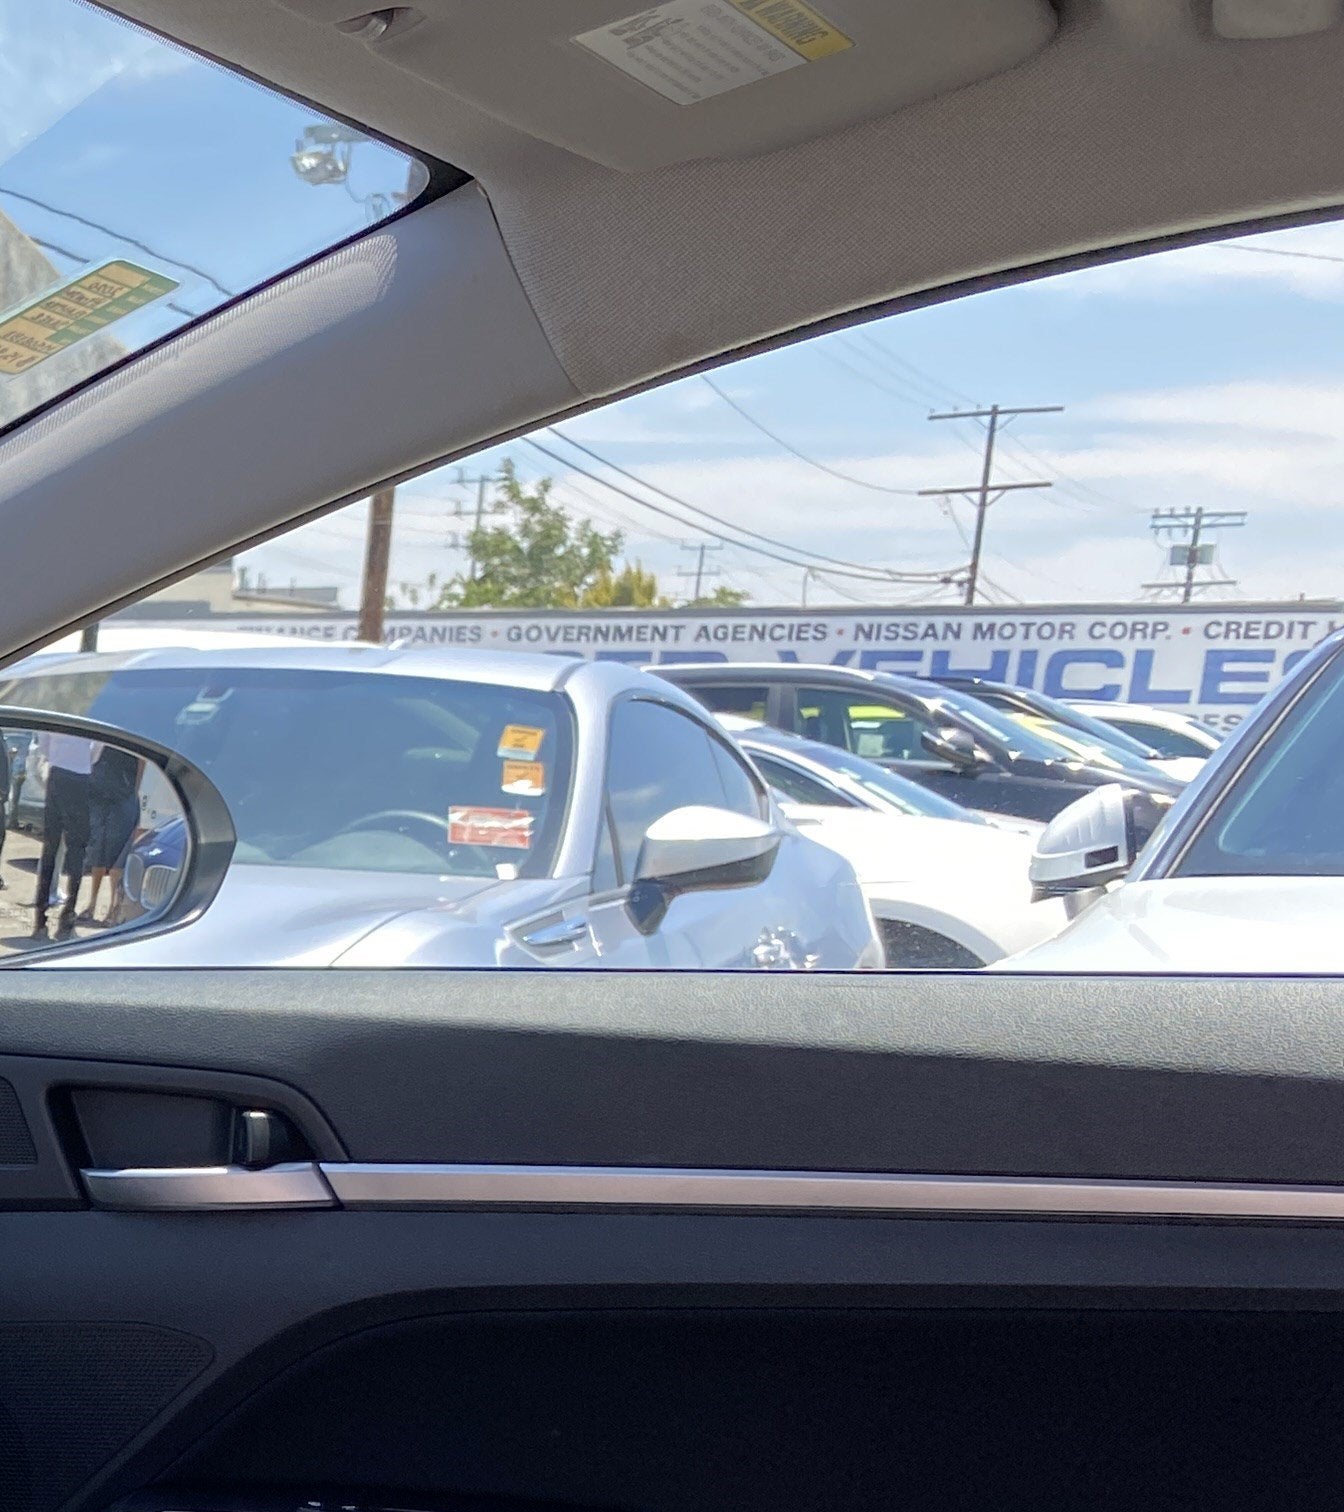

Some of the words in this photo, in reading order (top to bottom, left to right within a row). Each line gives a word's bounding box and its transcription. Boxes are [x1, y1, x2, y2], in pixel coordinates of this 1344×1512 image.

[343, 624, 481, 643] CMPANIES
[507, 624, 685, 643] GOVERNMENT
[694, 622, 827, 642] AGENCIES
[854, 621, 962, 642] NISSAN
[973, 621, 1075, 641] MOTOR
[1088, 620, 1172, 641] CORP.
[1204, 619, 1316, 641] CREDIT
